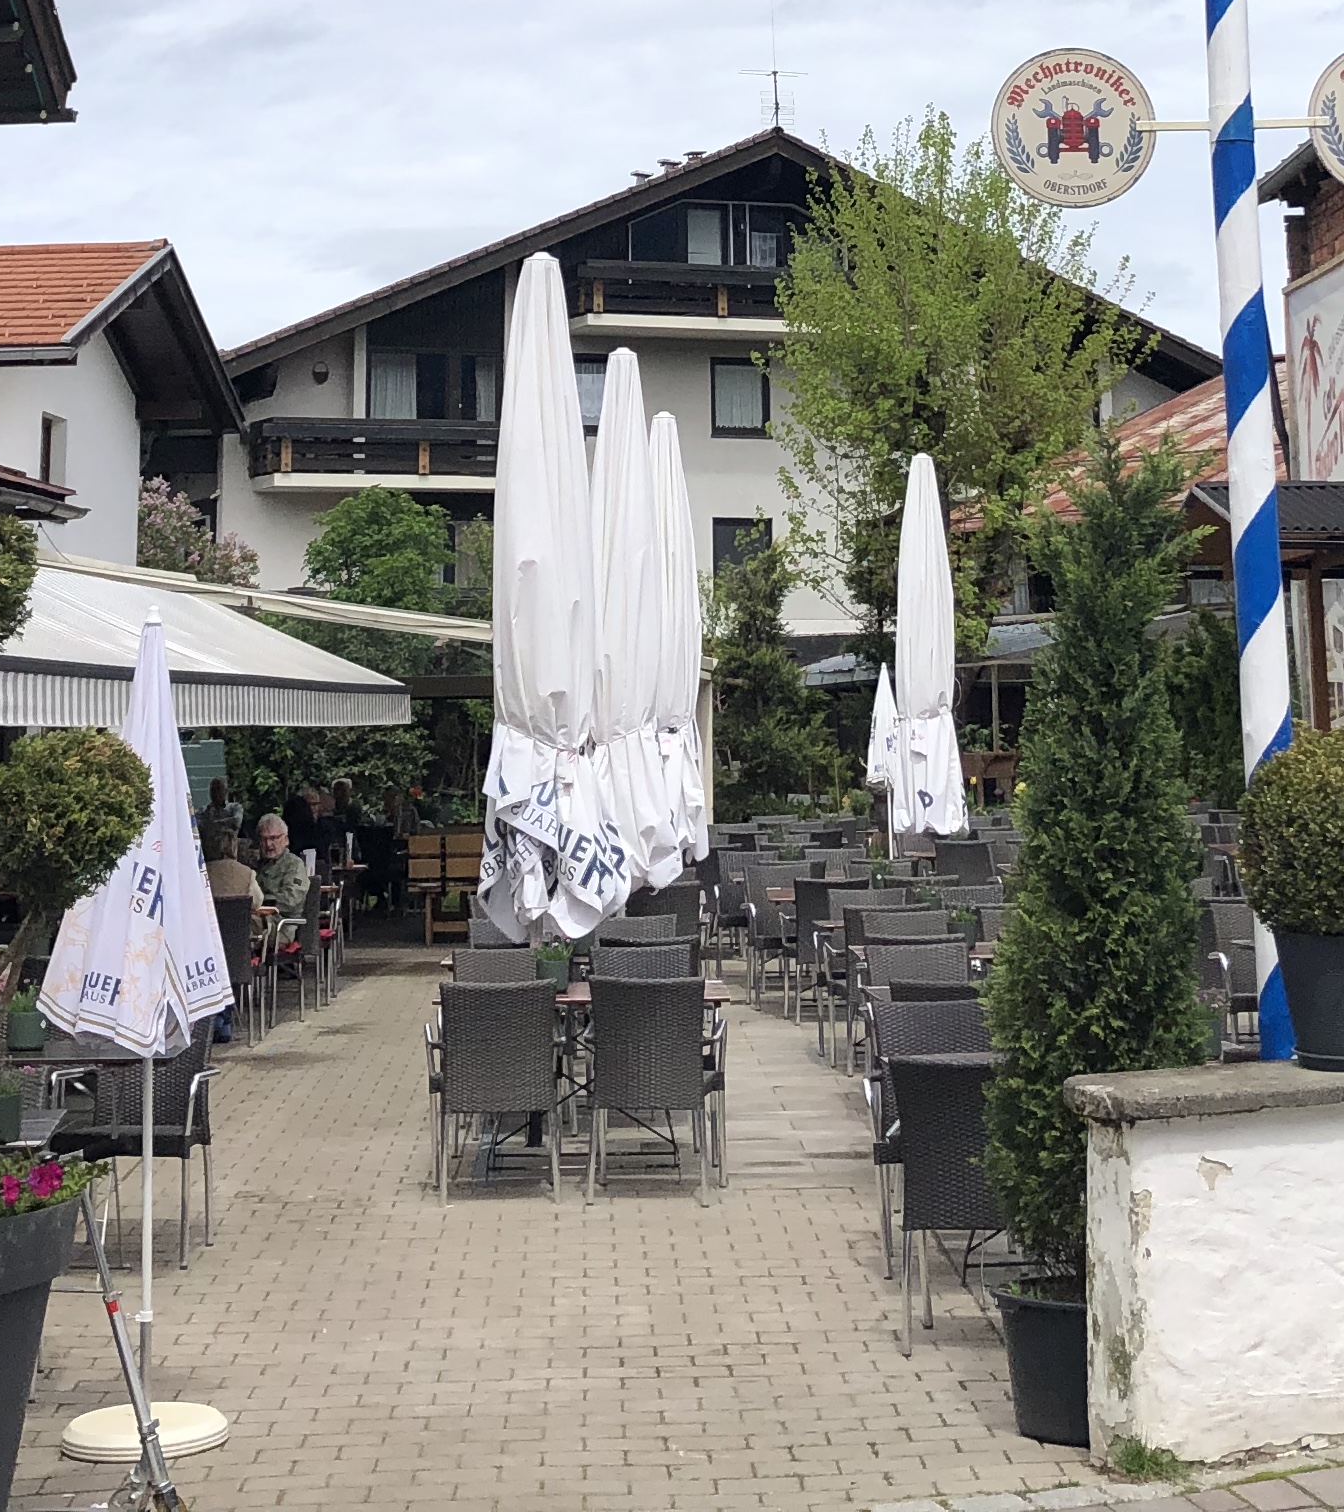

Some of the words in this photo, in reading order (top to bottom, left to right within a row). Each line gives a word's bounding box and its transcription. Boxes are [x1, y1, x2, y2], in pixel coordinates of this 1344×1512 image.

[1006, 58, 1136, 110] Mechatroniker
[1040, 79, 1102, 95] Landmaschinen
[1043, 178, 1108, 196] OBERSTDORF
